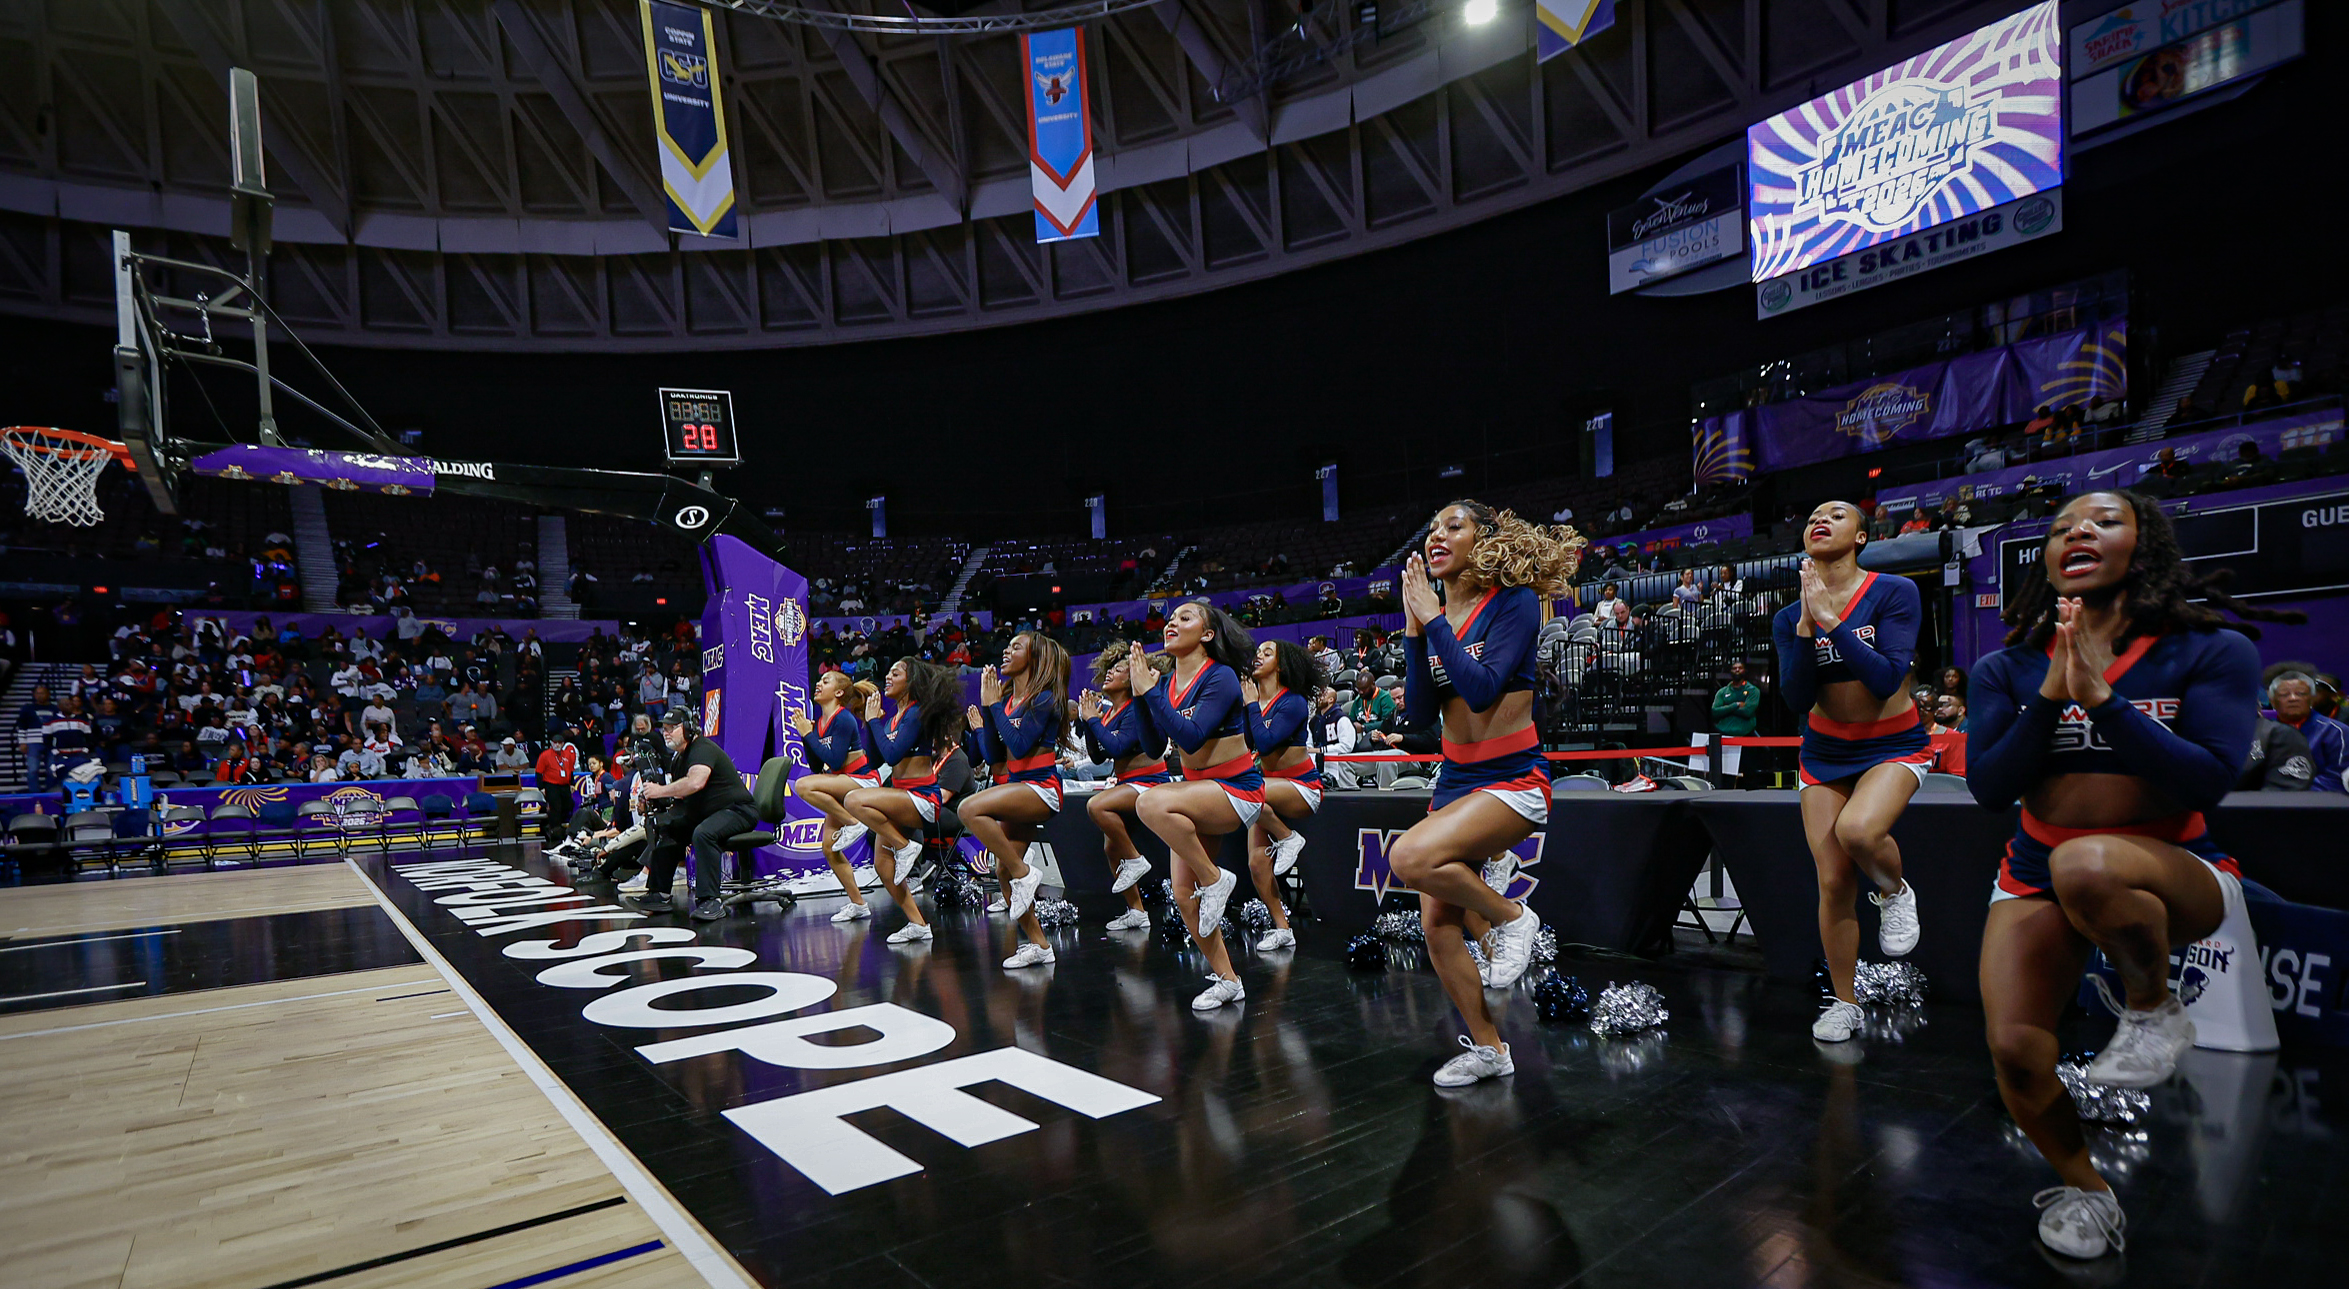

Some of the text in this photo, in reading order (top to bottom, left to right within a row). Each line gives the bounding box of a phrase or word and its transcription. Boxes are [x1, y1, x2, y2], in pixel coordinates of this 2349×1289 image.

[663, 91, 710, 109] UNIVERSITY
[1038, 112, 1078, 123] UNIVERSITY
[1842, 99, 1937, 157] MEAC
[1804, 107, 1993, 201] HOMECOMING
[1861, 172, 1928, 214] 2026
[1642, 217, 1719, 257] FUSION
[1669, 234, 1720, 260] POOLS
[1800, 213, 2003, 293] ICE SKATING
[1815, 284, 1847, 300] LESSONS
[1889, 262, 1921, 278] PARTIES
[1926, 242, 1987, 270] TOURNAMENTS
[1840, 398, 1925, 427] HOMECOMING
[432, 460, 496, 481] ALDING
[1980, 594, 1997, 606] EXIT
[743, 592, 774, 665] MEAC
[702, 643, 725, 677] MEAC
[390, 857, 648, 938] NORFOLK
[501, 927, 1163, 1197] SCOPE
